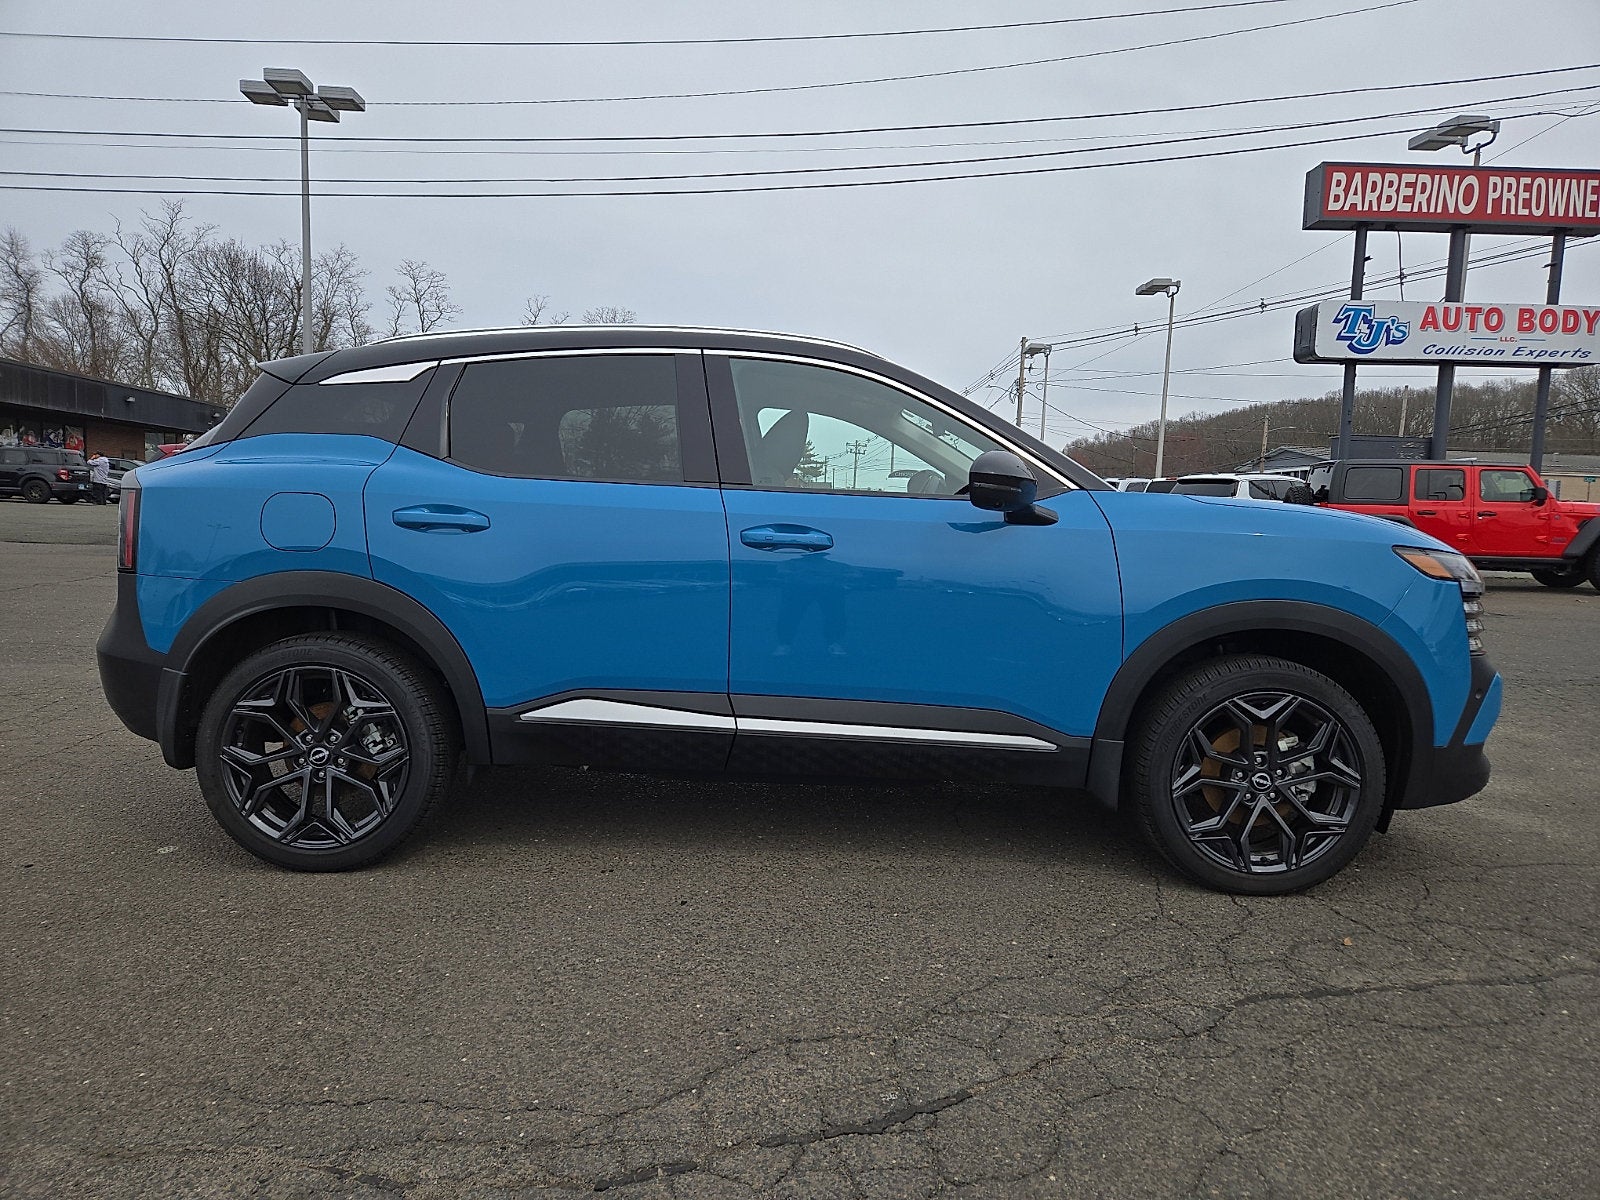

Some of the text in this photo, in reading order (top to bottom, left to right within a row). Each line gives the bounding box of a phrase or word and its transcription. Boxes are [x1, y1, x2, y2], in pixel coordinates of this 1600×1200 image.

[1327, 171, 1600, 218] BARBERINO PREOWNE
[1419, 305, 1600, 335] AUTO BODY
[1422, 344, 1592, 360] Collision Experts
